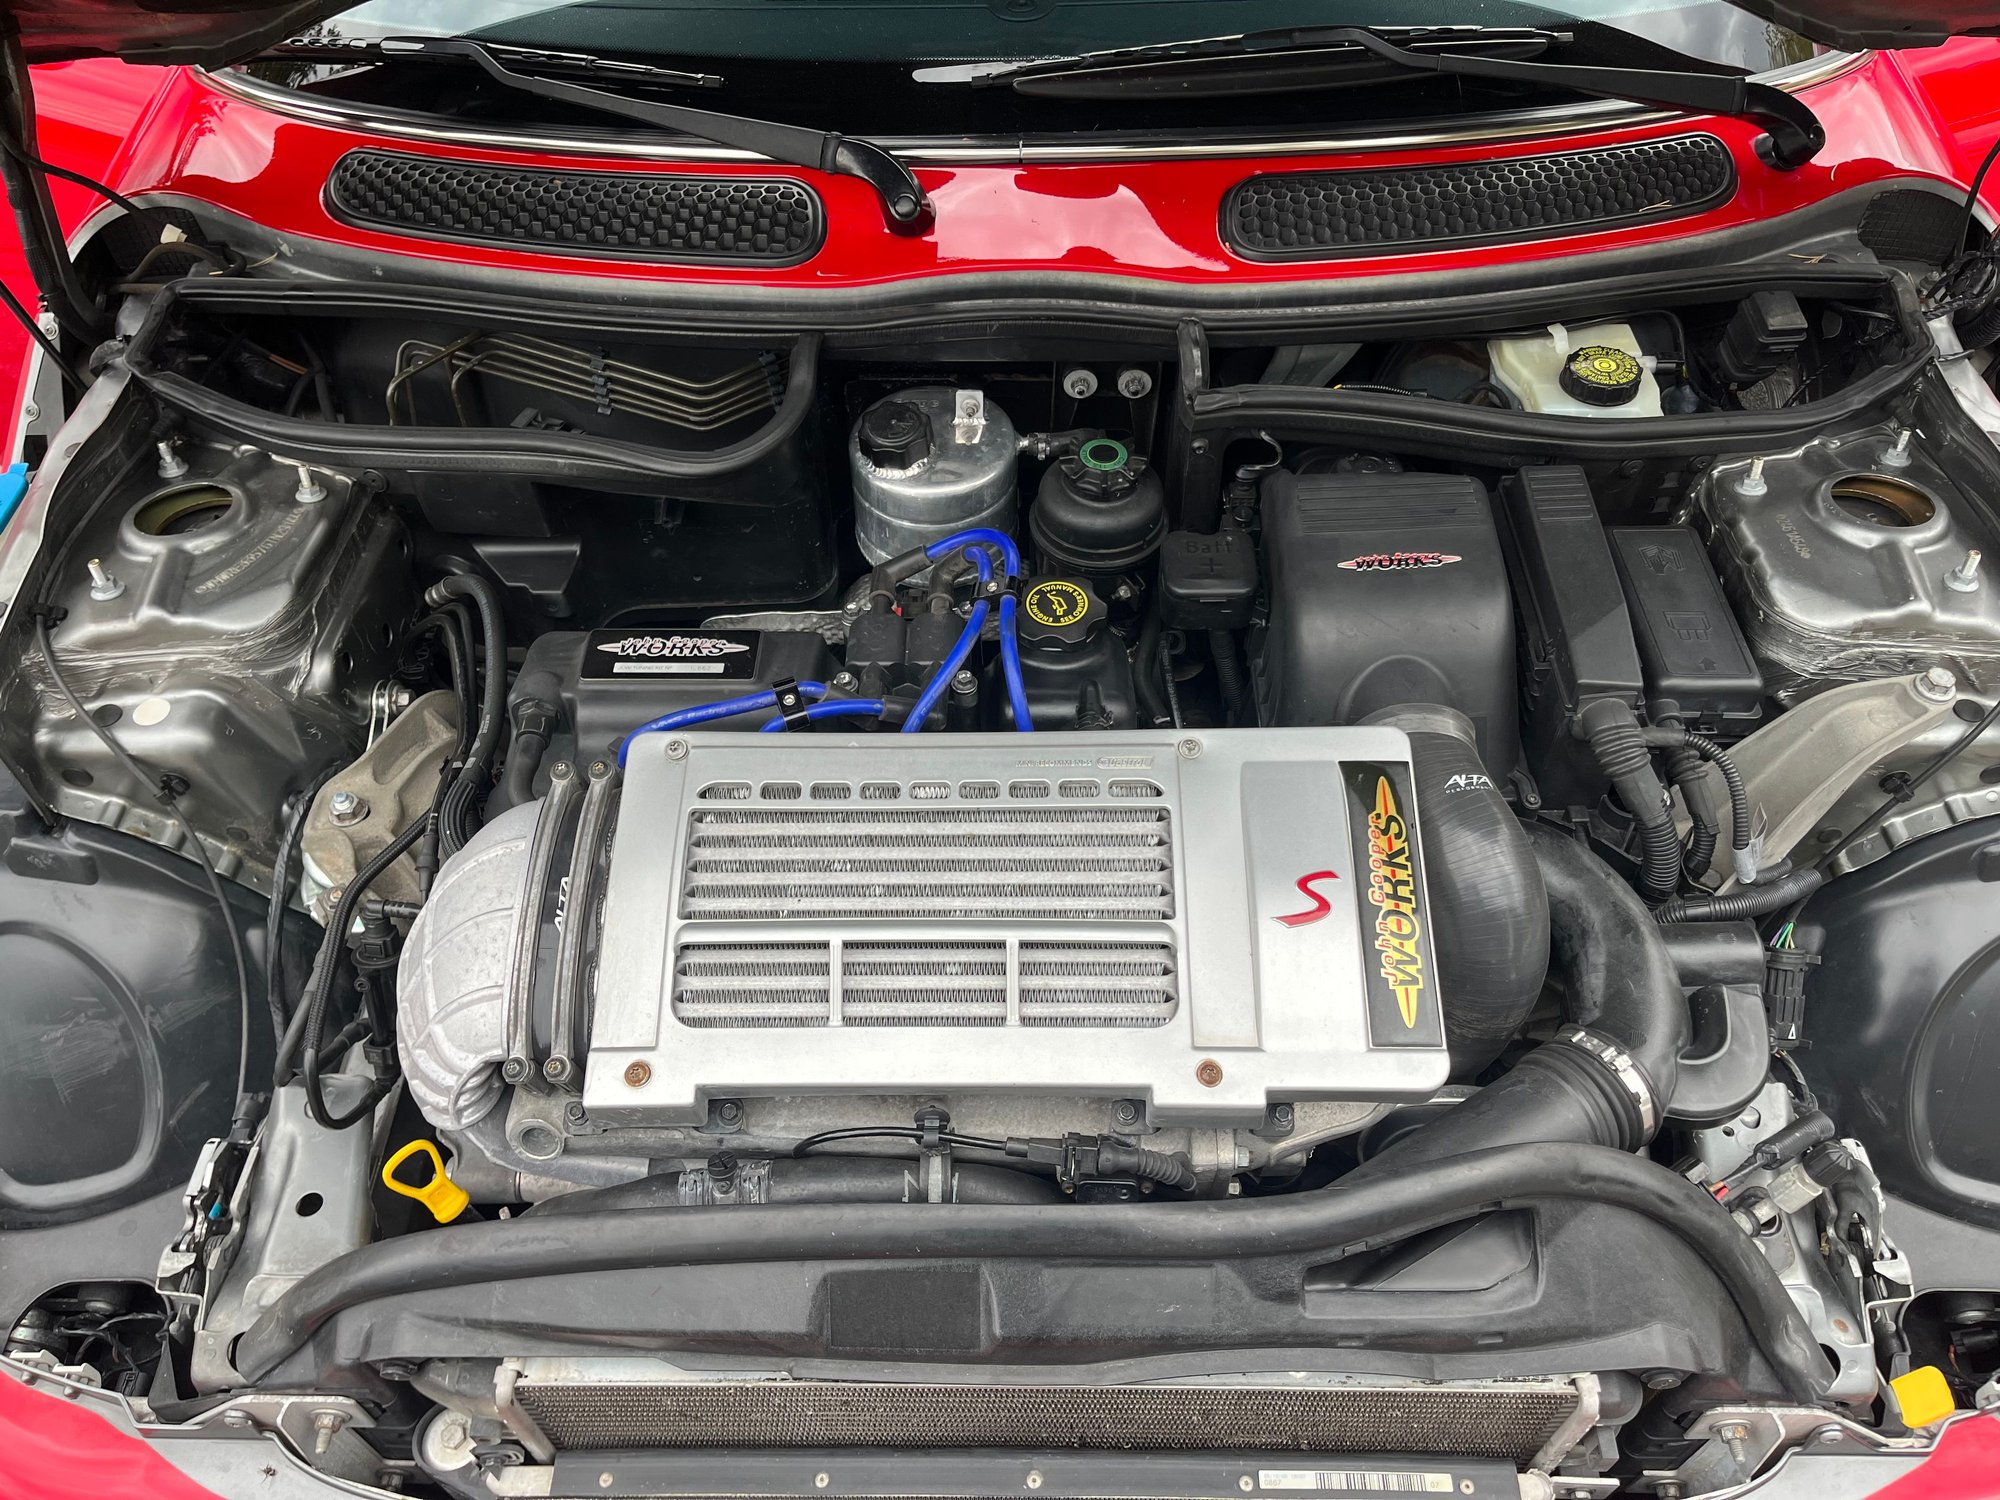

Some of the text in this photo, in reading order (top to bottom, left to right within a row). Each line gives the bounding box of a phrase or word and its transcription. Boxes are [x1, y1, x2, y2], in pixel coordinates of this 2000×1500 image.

[1355, 554, 1443, 571] WORKS
[1041, 584, 1070, 593] MANUAL
[1030, 594, 1054, 623] ENGINE OIL
[1060, 615, 1075, 623] SEE
[618, 639, 727, 656] WORKS
[1443, 774, 1494, 789] ALTA
[1272, 869, 1341, 928] S
[1368, 813, 1399, 986] John Cooper
[1376, 814, 1423, 989] WORKS
